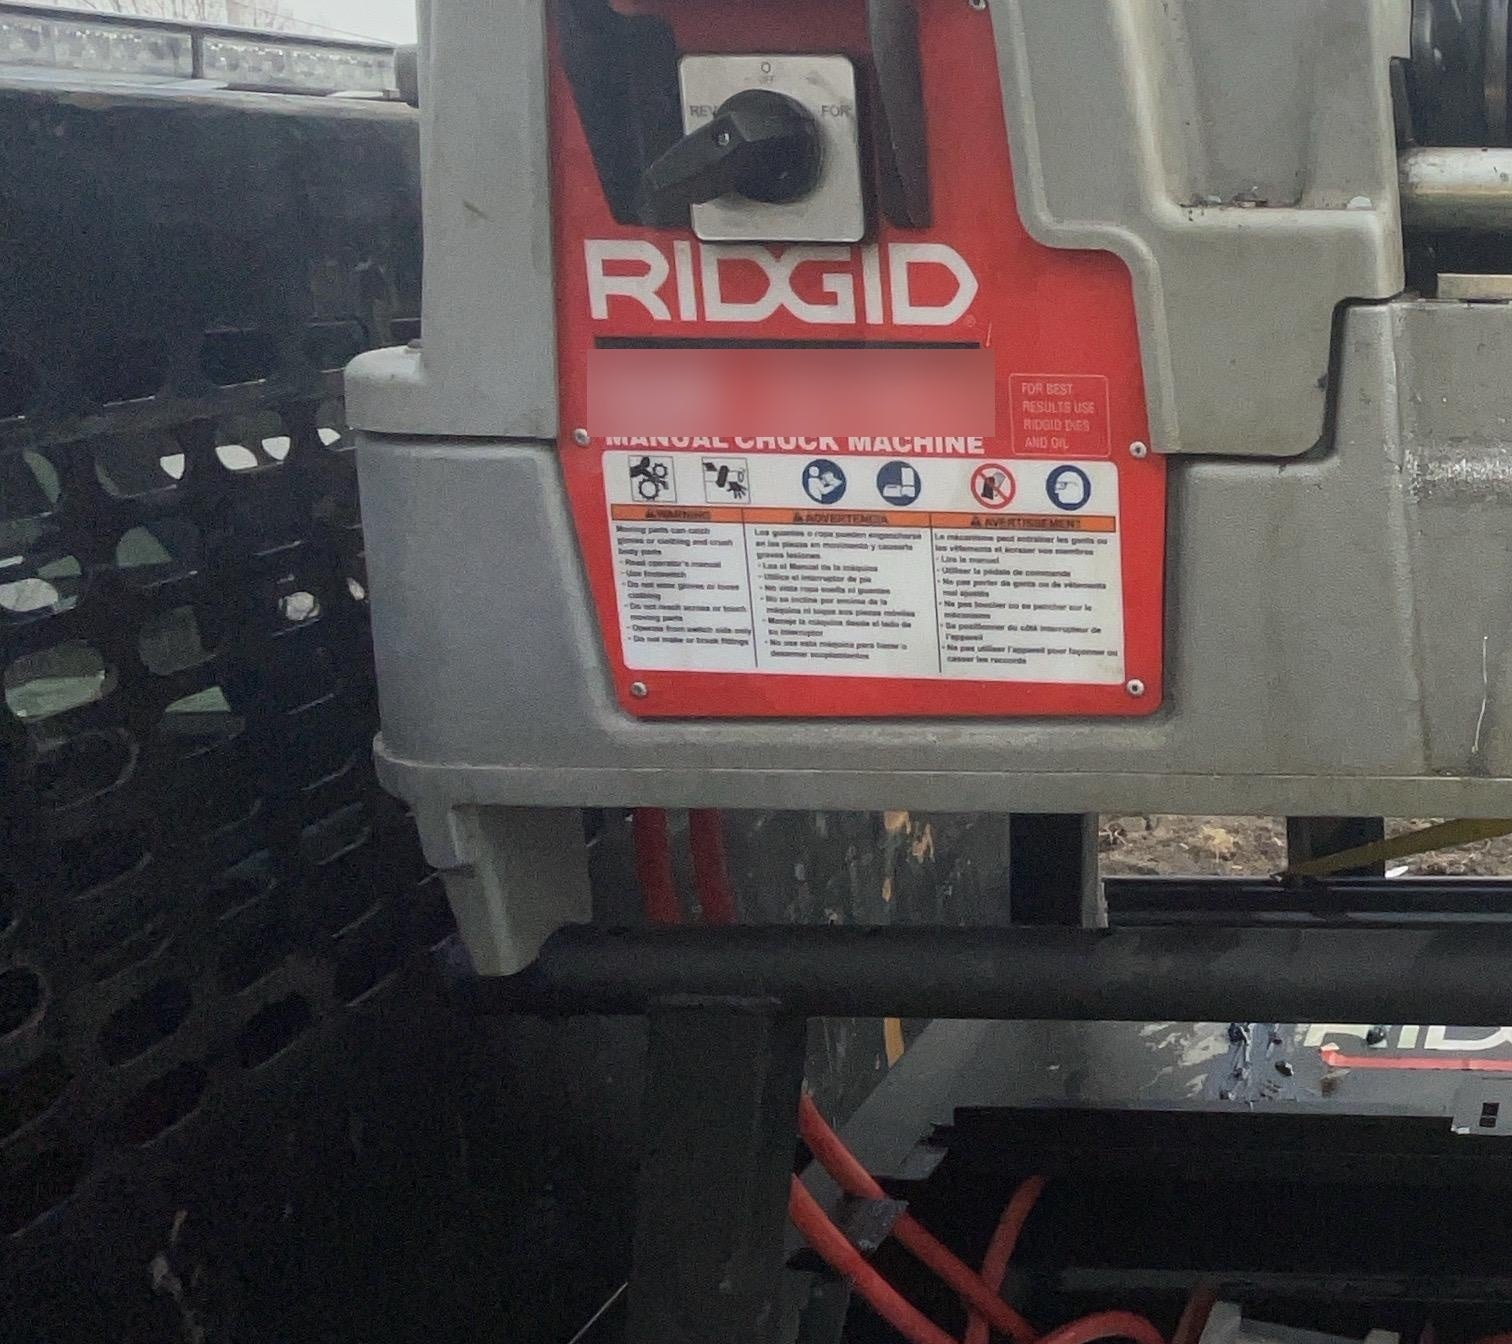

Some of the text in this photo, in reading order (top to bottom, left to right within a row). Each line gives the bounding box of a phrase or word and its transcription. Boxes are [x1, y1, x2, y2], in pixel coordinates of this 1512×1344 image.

[584, 239, 979, 325] RIDGID
[1046, 383, 1073, 395] BEST
[1022, 401, 1095, 414] RESULTS USE
[848, 436, 986, 454] MACHINE
